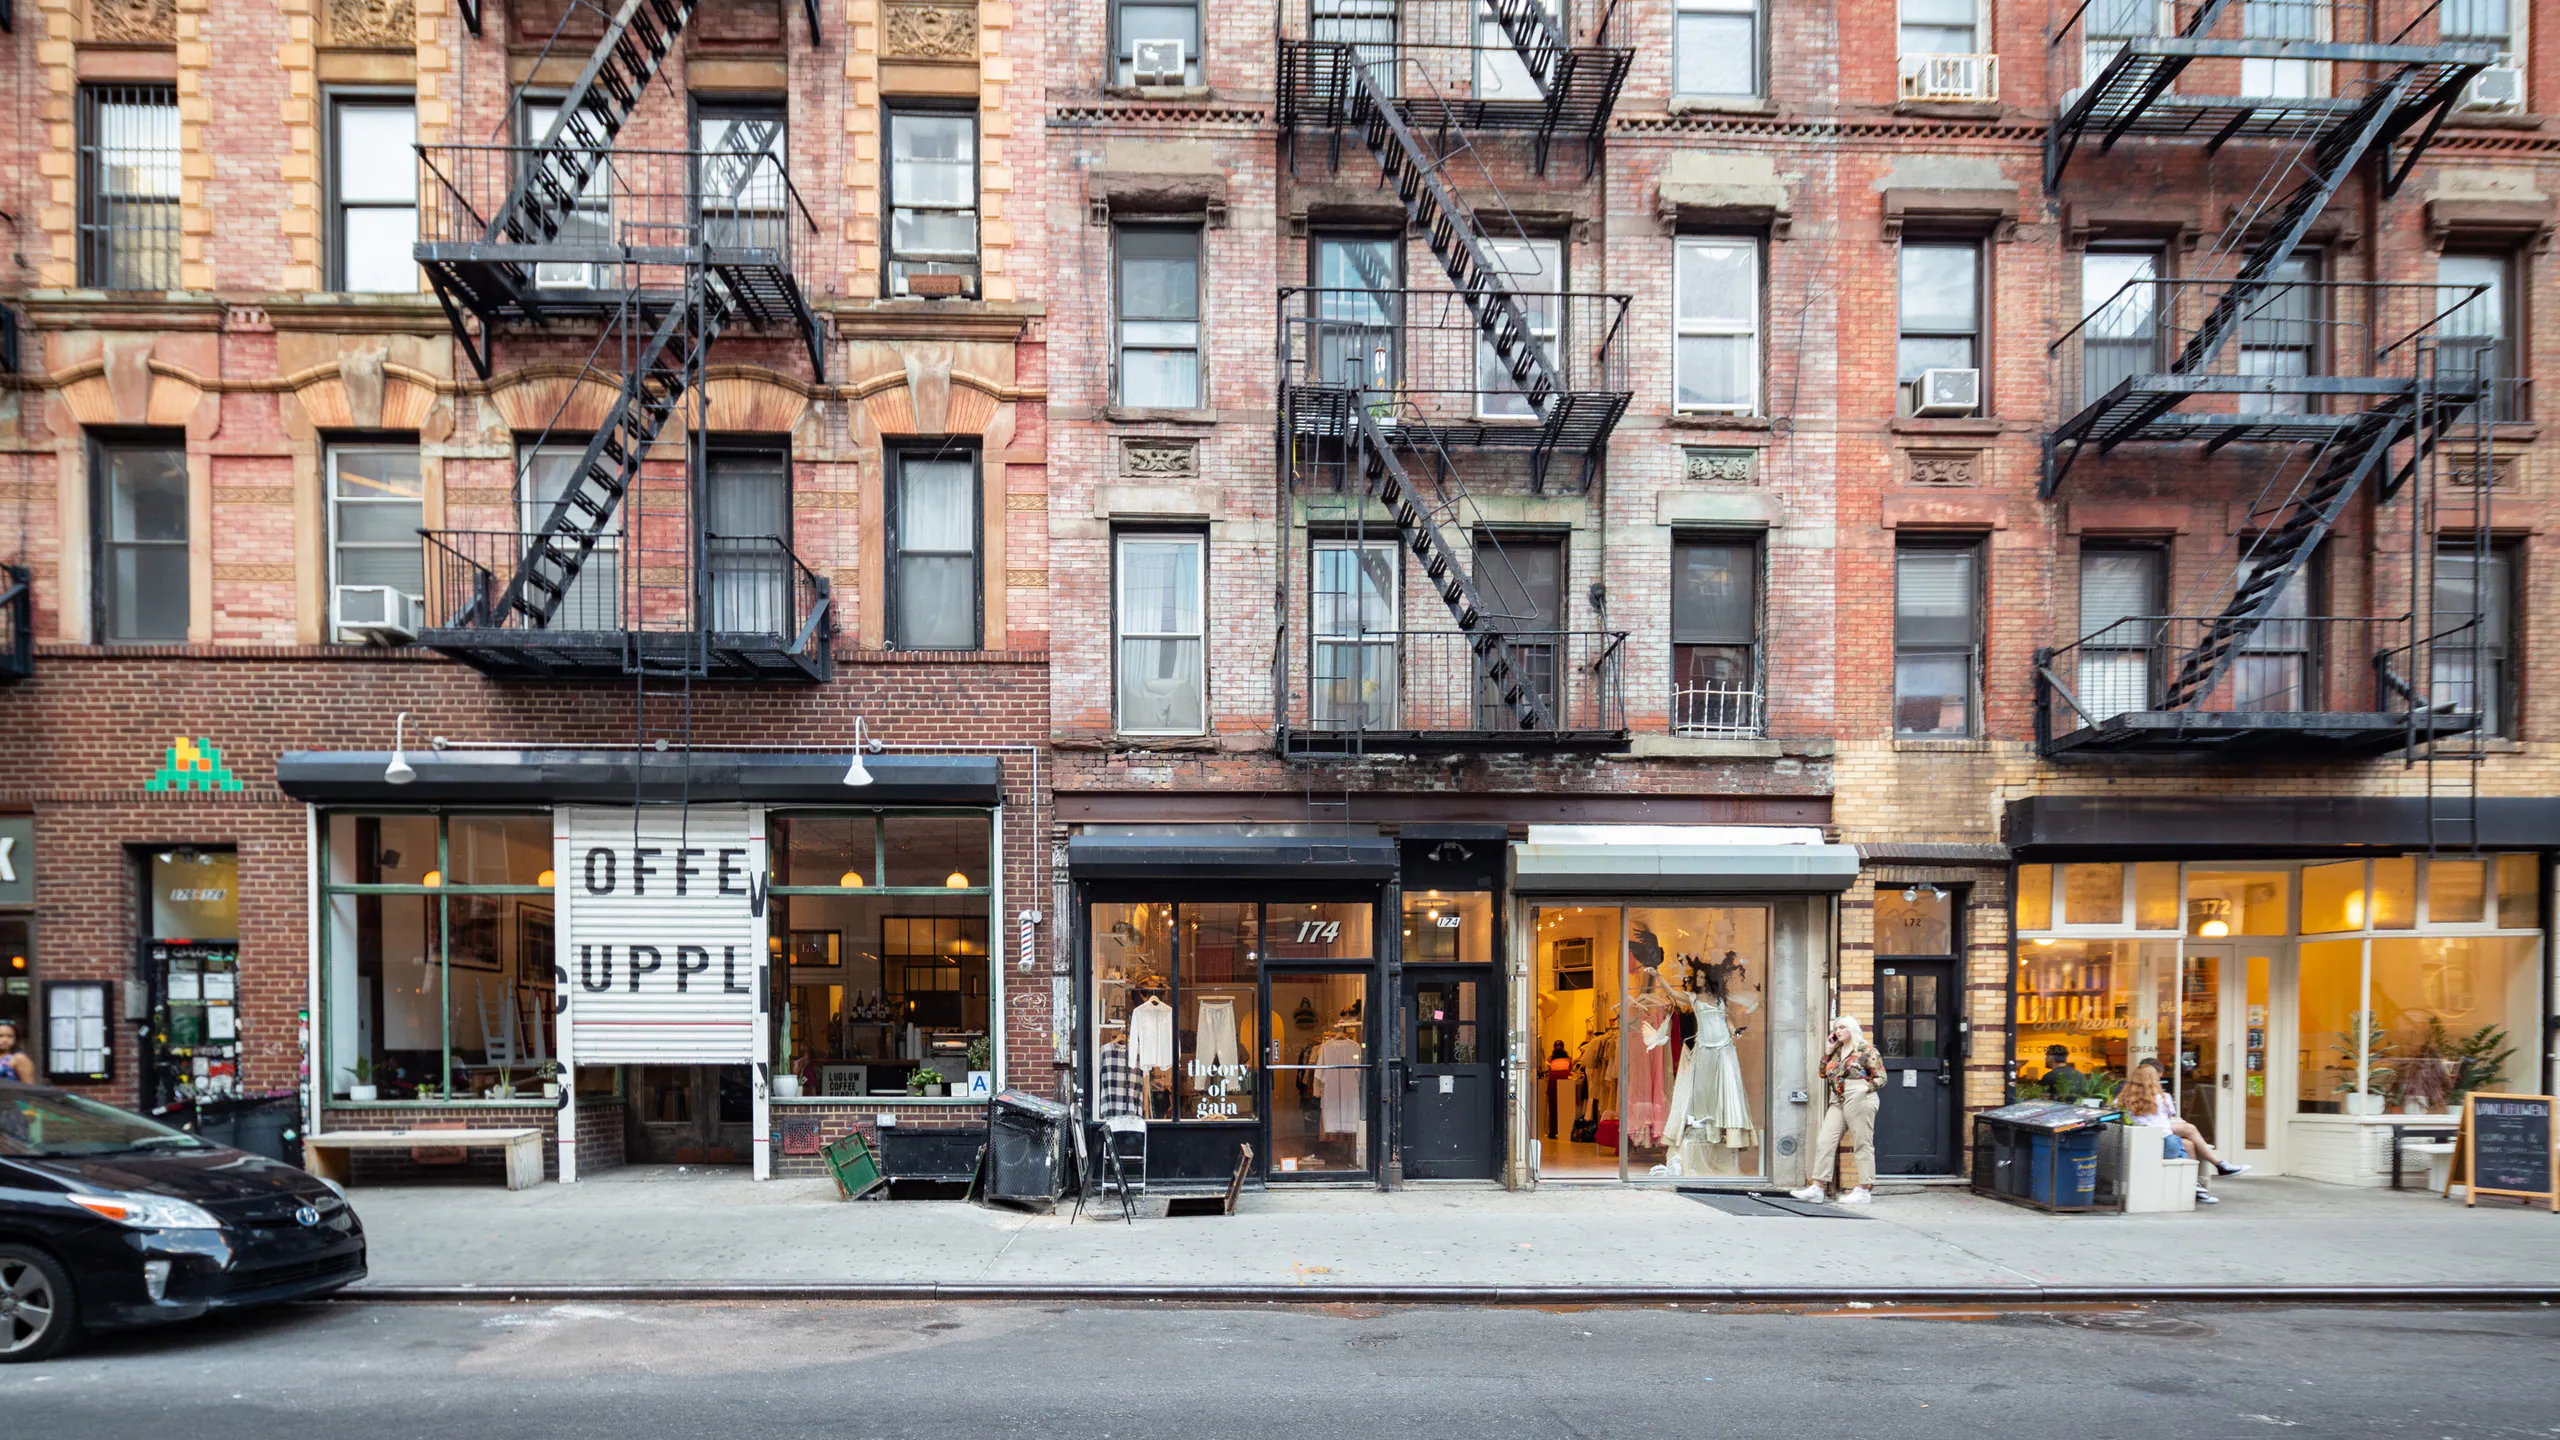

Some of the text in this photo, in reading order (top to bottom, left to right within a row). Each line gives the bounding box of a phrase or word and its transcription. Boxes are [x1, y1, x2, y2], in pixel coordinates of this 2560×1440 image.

[584, 847, 748, 896] OFFE
[2201, 899, 2231, 915] 172
[1439, 917, 1459, 927] 174
[1904, 918, 1921, 927] 172
[1296, 921, 1341, 944] 174
[581, 944, 749, 993] UPPL
[829, 1072, 860, 1081] LUDLOW
[1187, 1059, 1249, 1081] theory
[829, 1082, 856, 1091] COFFEE
[973, 1075, 987, 1092] A
[1208, 1078, 1230, 1097] of
[1196, 1097, 1238, 1120] gaia
